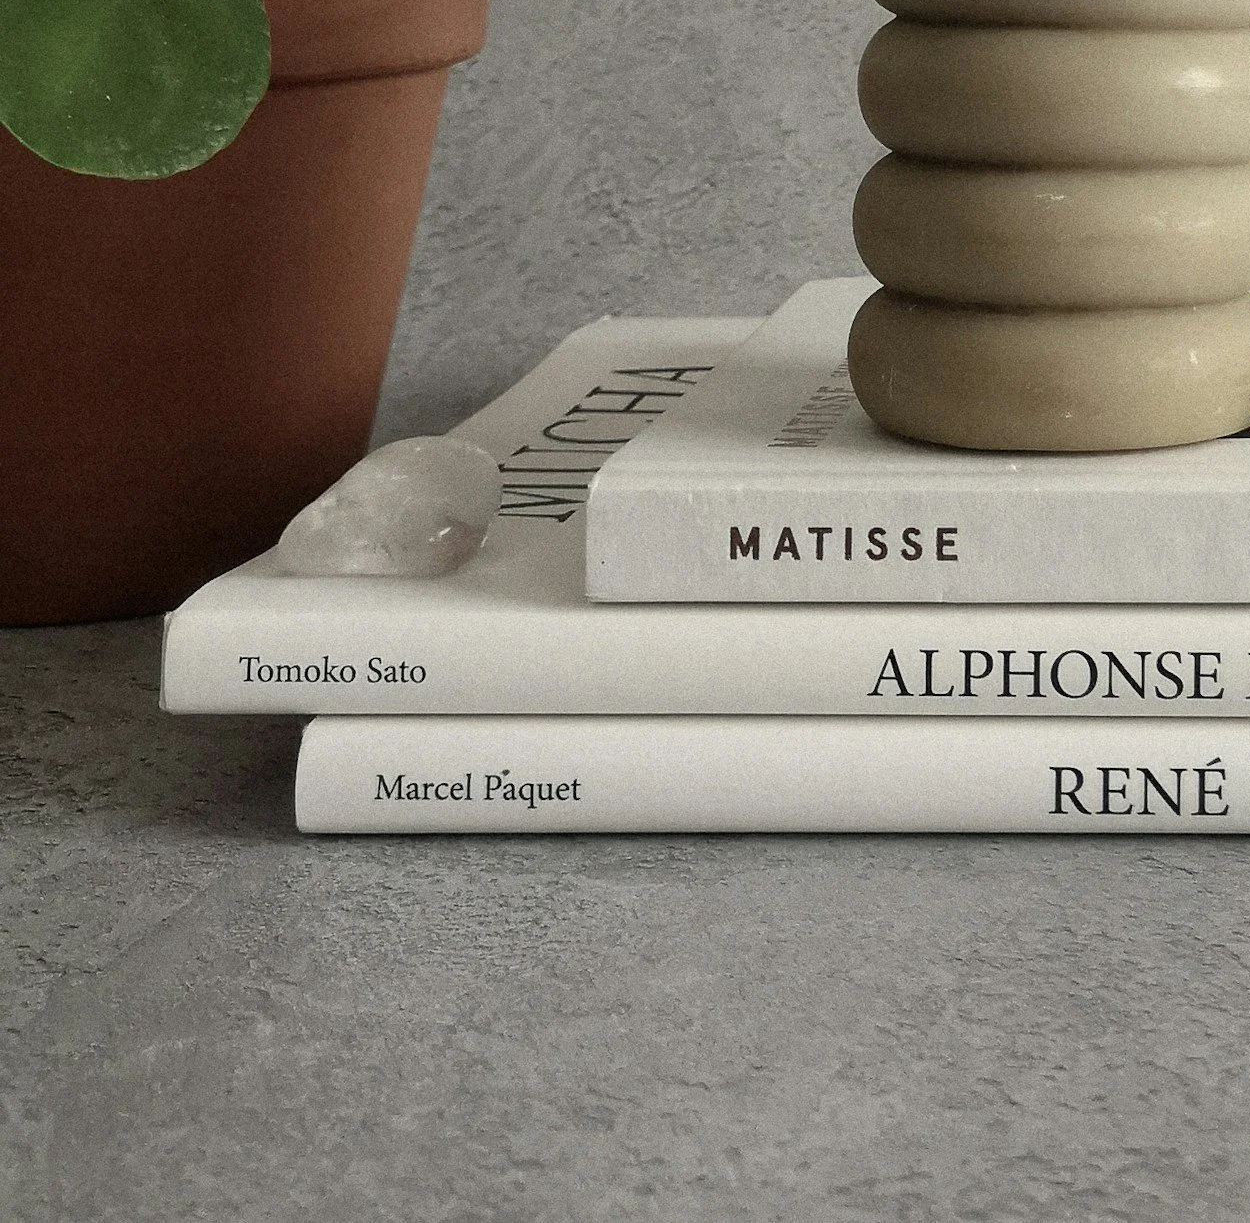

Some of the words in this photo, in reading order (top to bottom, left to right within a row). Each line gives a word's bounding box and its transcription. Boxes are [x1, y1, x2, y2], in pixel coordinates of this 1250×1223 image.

[729, 526, 958, 562] MATISSE
[238, 655, 357, 683] Tomoko
[367, 657, 427, 684] Sato
[866, 648, 1225, 700] ALPHONSE
[374, 773, 473, 801] Marcel
[484, 773, 581, 810] Paquet
[1048, 757, 1230, 817] RENÉ
